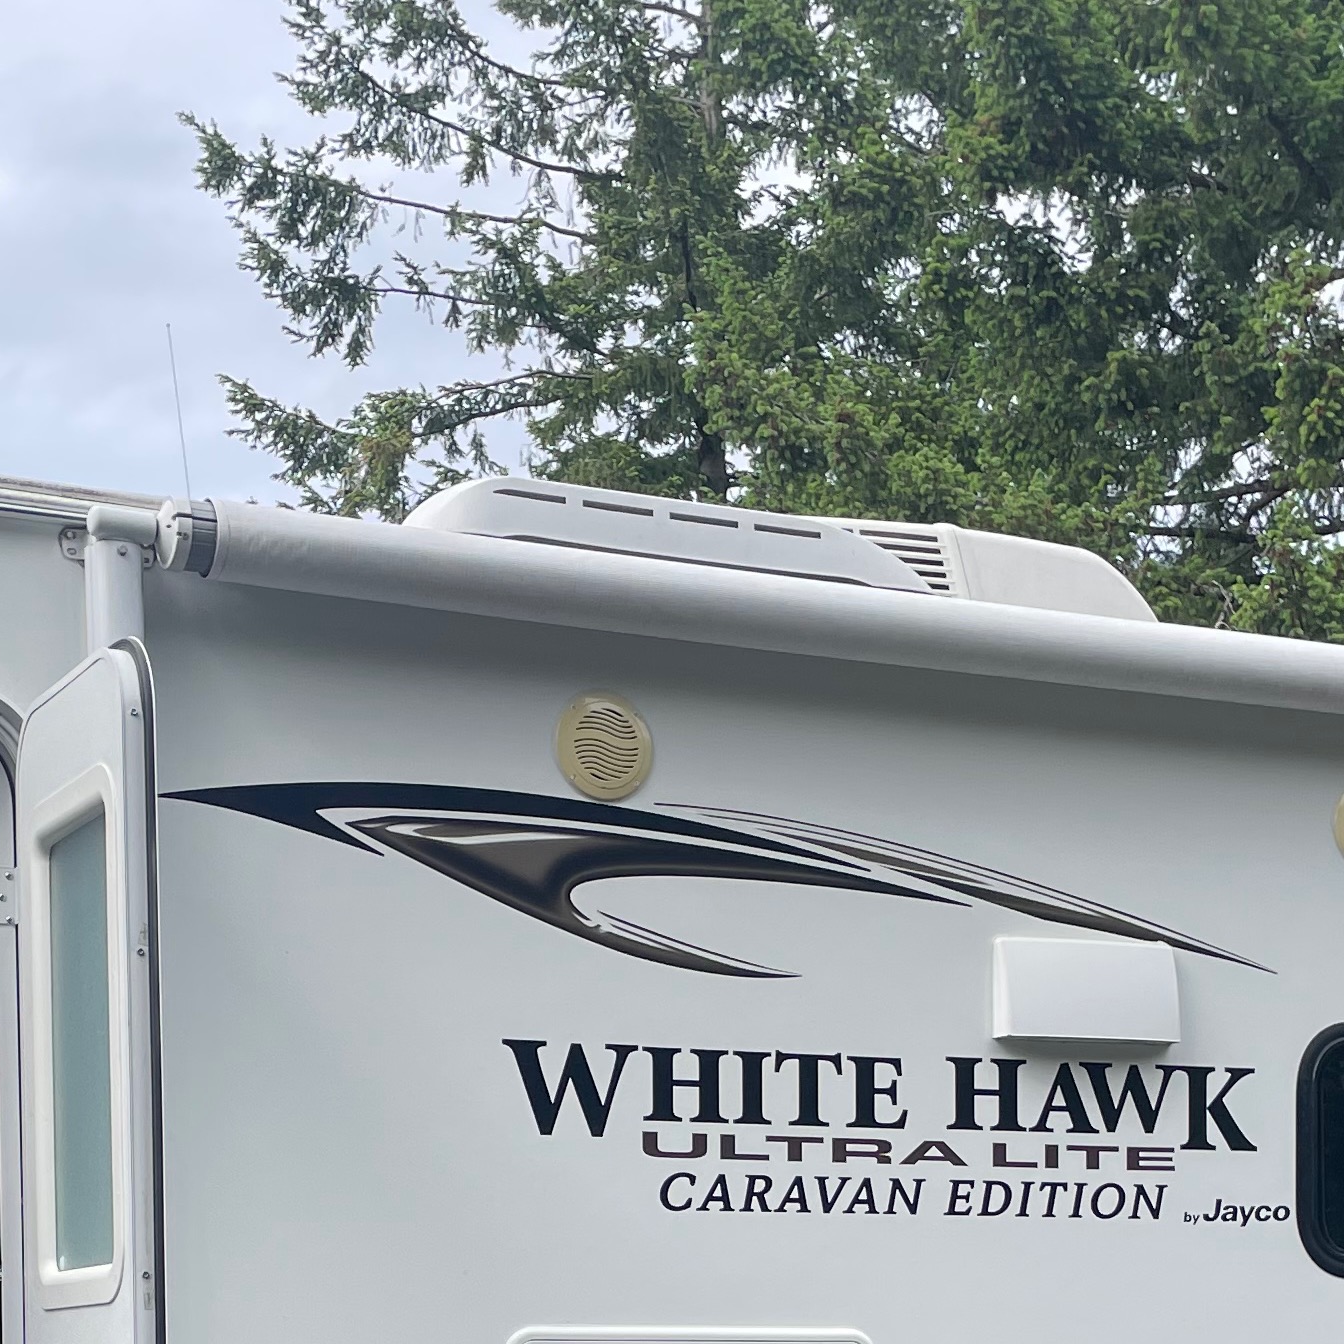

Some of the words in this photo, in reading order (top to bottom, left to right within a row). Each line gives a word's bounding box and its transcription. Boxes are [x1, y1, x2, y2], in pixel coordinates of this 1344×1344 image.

[502, 1039, 908, 1137] WHITE
[946, 1057, 1257, 1152] HAWK
[642, 1131, 969, 1167] ULTRA
[992, 1142, 1176, 1172] LITE
[659, 1172, 927, 1216] CARAVAN
[943, 1179, 1168, 1220] EDITION
[1183, 1211, 1200, 1225] by
[1203, 1199, 1291, 1227] Jayco
